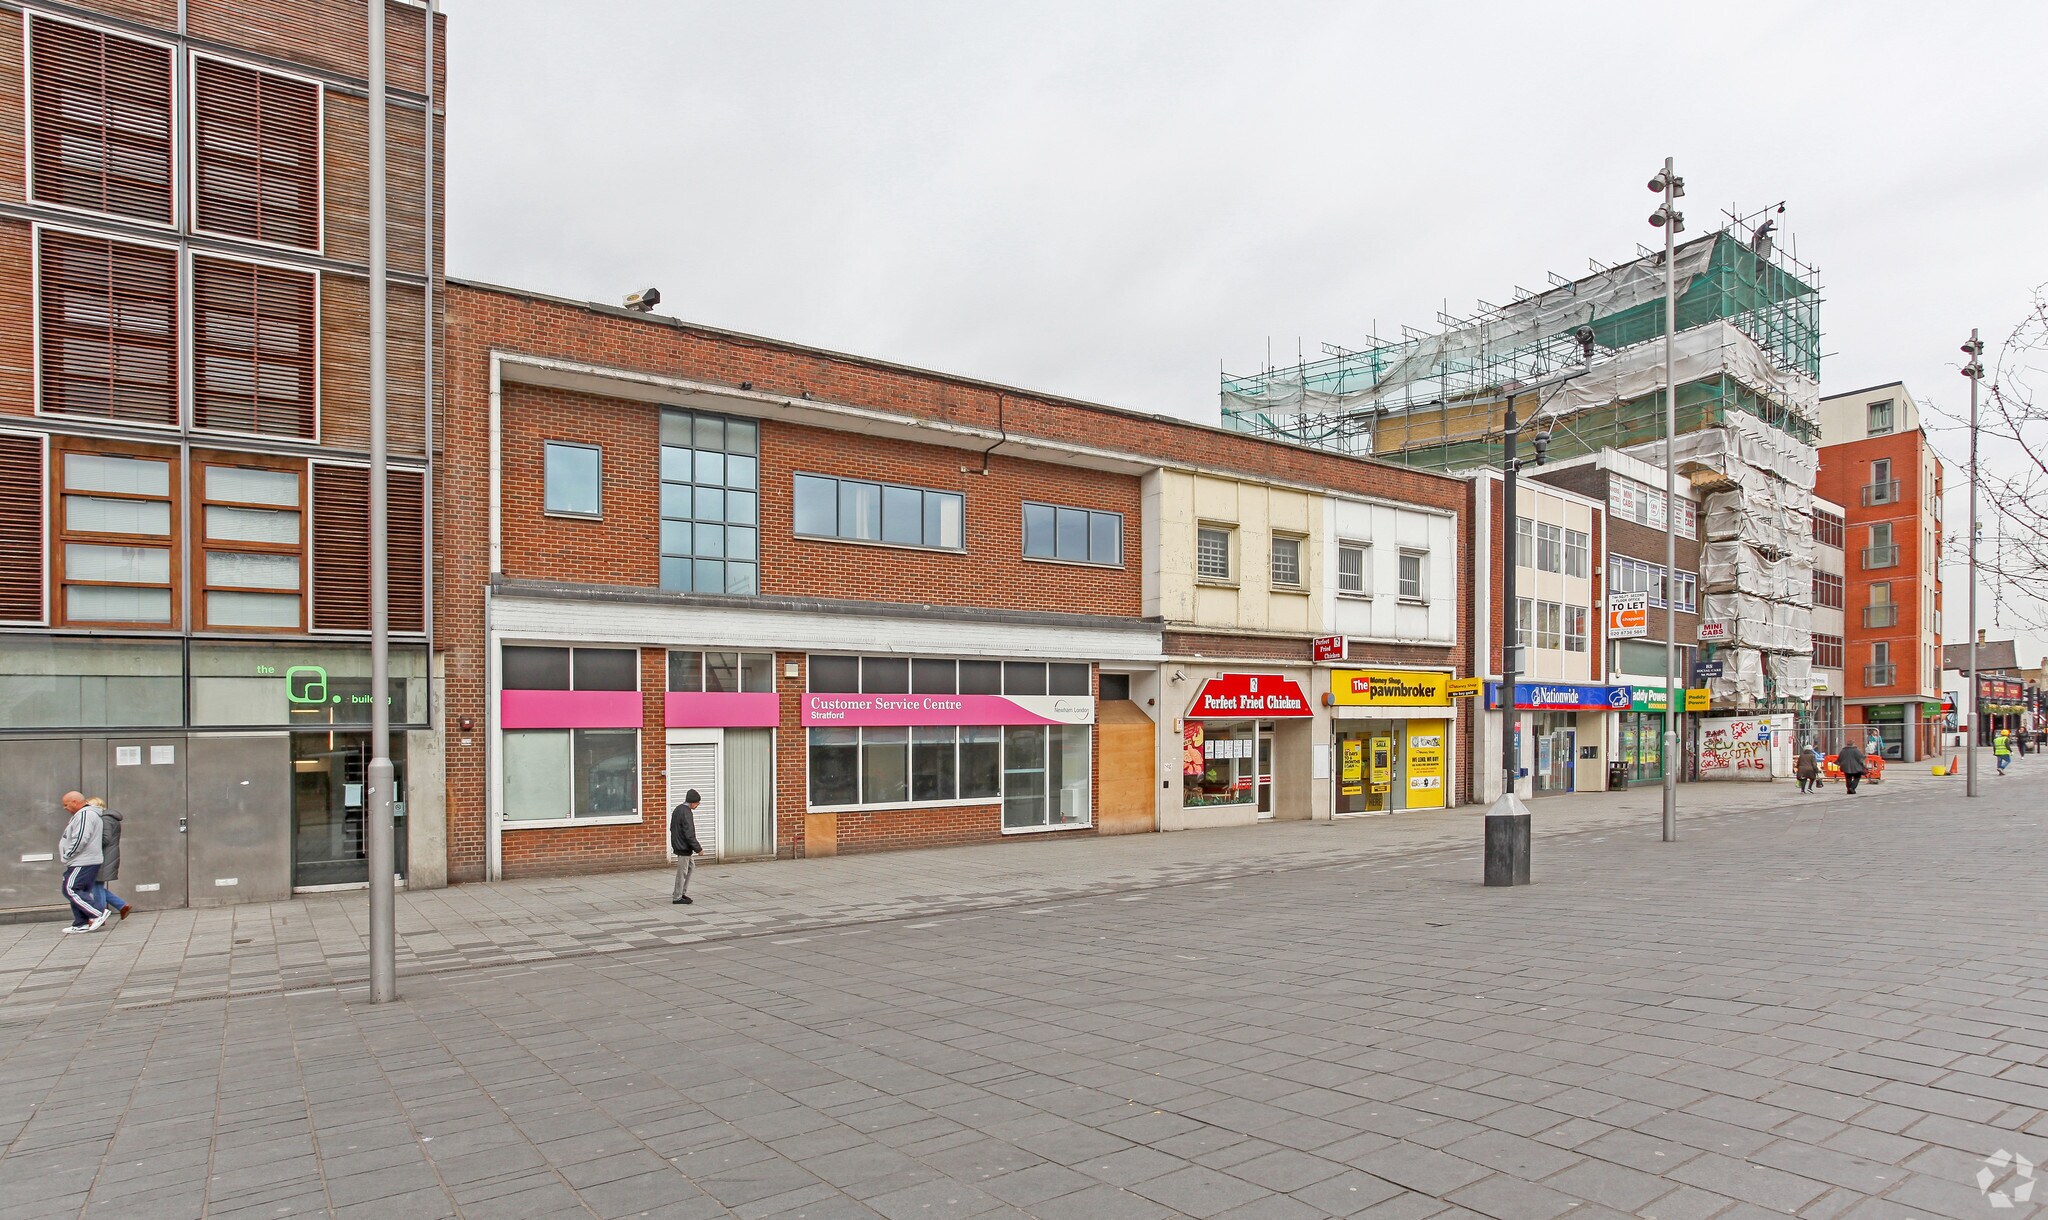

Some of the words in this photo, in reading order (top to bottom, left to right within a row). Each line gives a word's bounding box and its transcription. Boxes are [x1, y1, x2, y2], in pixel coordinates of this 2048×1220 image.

[1611, 603, 1625, 611] TO
[1627, 601, 1645, 610] LET
[1703, 623, 1722, 631] MINI
[256, 665, 275, 674] the
[1353, 680, 1369, 691] The
[1369, 676, 1388, 685] Money
[1388, 677, 1402, 686] Shop
[1369, 683, 1436, 700] pawnbroker
[1540, 687, 1579, 704] Nationwide
[1632, 689, 1648, 705] addy
[811, 696, 873, 710] Customer
[875, 697, 920, 710] Service
[923, 697, 962, 710] Centre
[1204, 694, 1238, 709] Perfect
[1239, 694, 1265, 709] Fried
[1266, 694, 1301, 709] Chicken
[810, 711, 845, 719] Stratford
